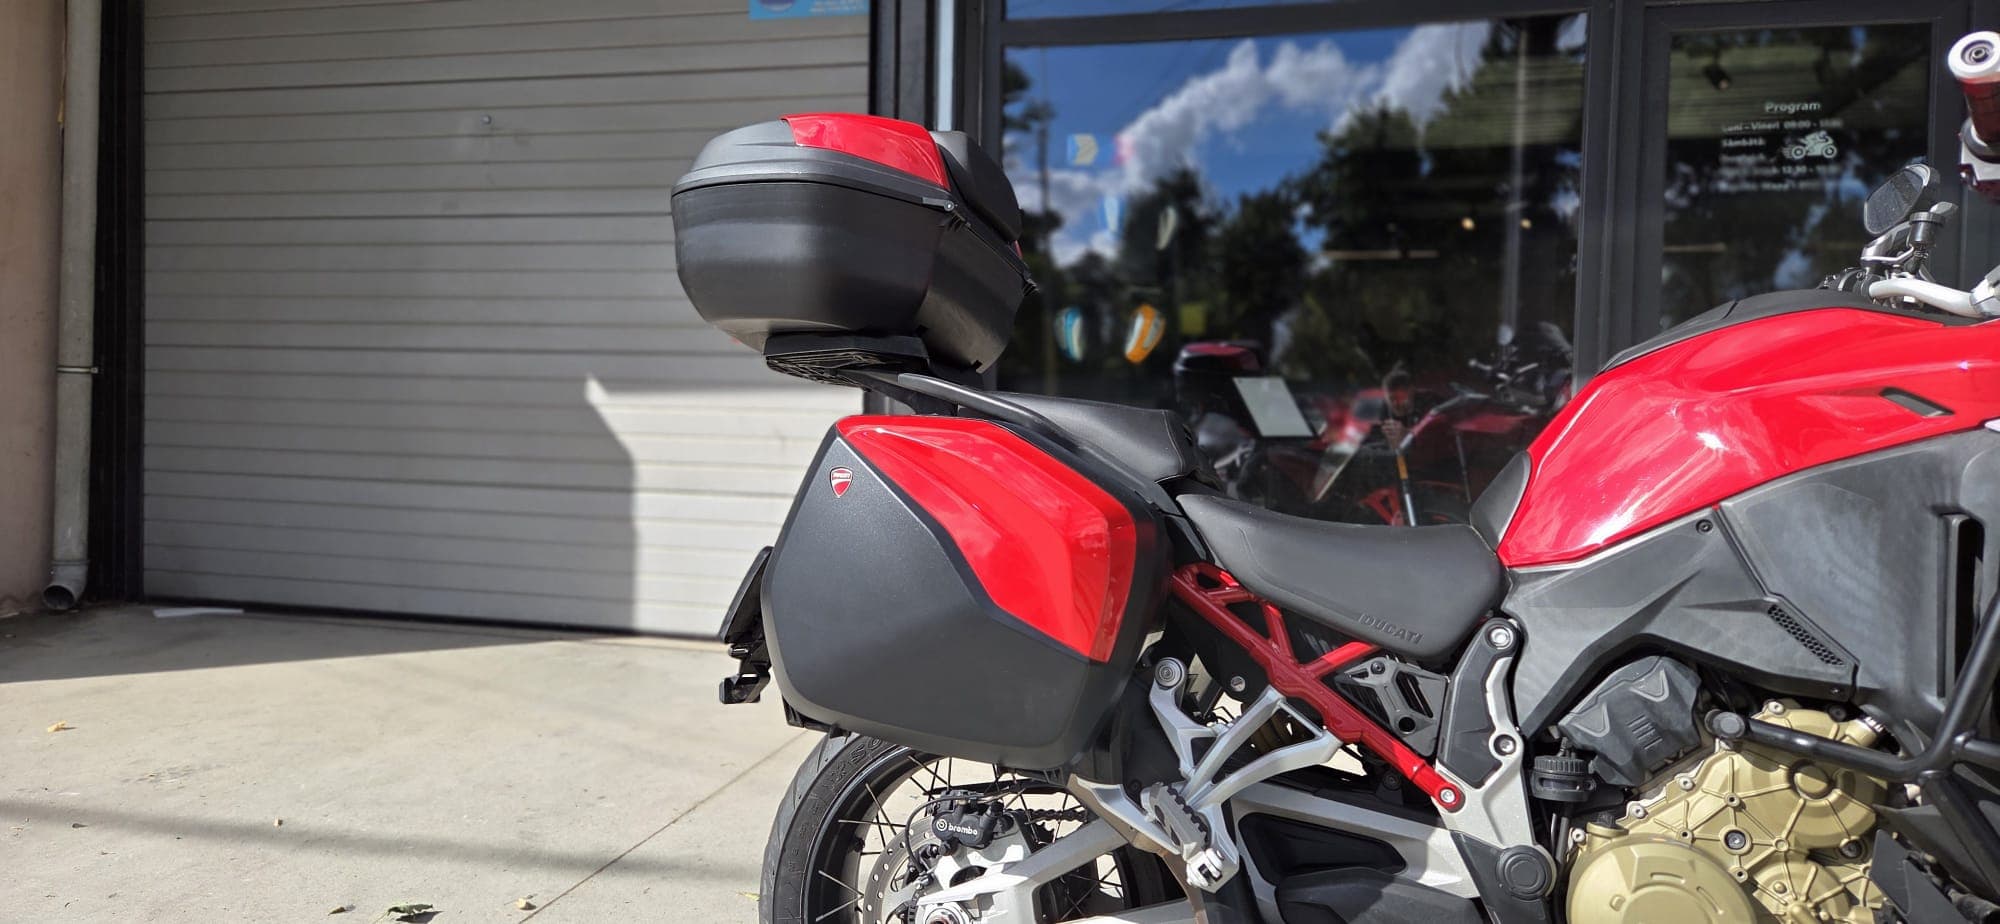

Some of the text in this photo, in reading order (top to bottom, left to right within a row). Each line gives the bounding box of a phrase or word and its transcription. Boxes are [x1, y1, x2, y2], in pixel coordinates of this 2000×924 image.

[1764, 102, 1821, 115] Program
[1359, 612, 1424, 644] DUCATI
[948, 822, 978, 836] brembo
